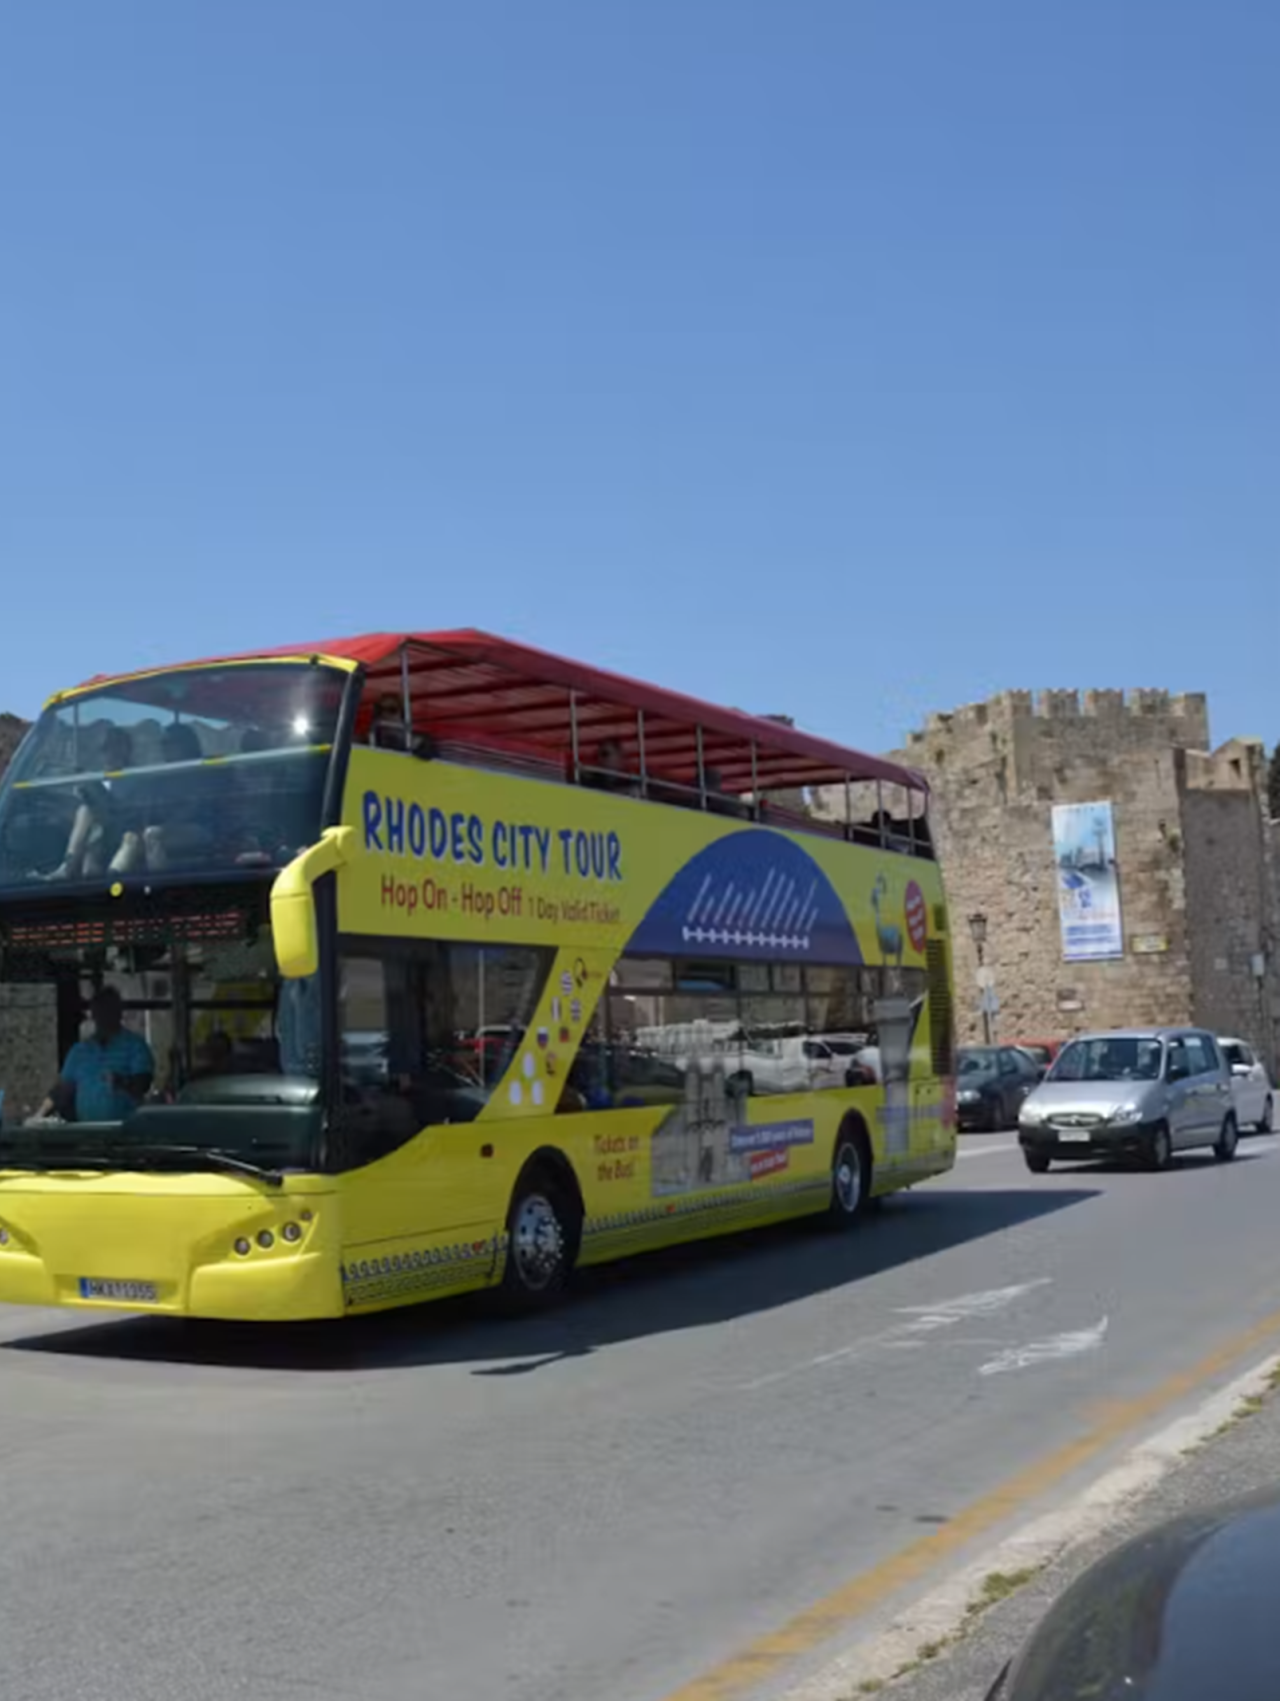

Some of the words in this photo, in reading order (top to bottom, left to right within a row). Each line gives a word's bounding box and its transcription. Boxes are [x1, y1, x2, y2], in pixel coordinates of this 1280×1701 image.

[362, 790, 483, 864] RHODES
[492, 820, 550, 871] CITY
[557, 829, 622, 881] TOUR
[381, 874, 418, 915] Hop
[422, 878, 447, 910] On
[461, 882, 494, 918] Hop
[498, 886, 522, 916] Off
[537, 897, 558, 924] Day
